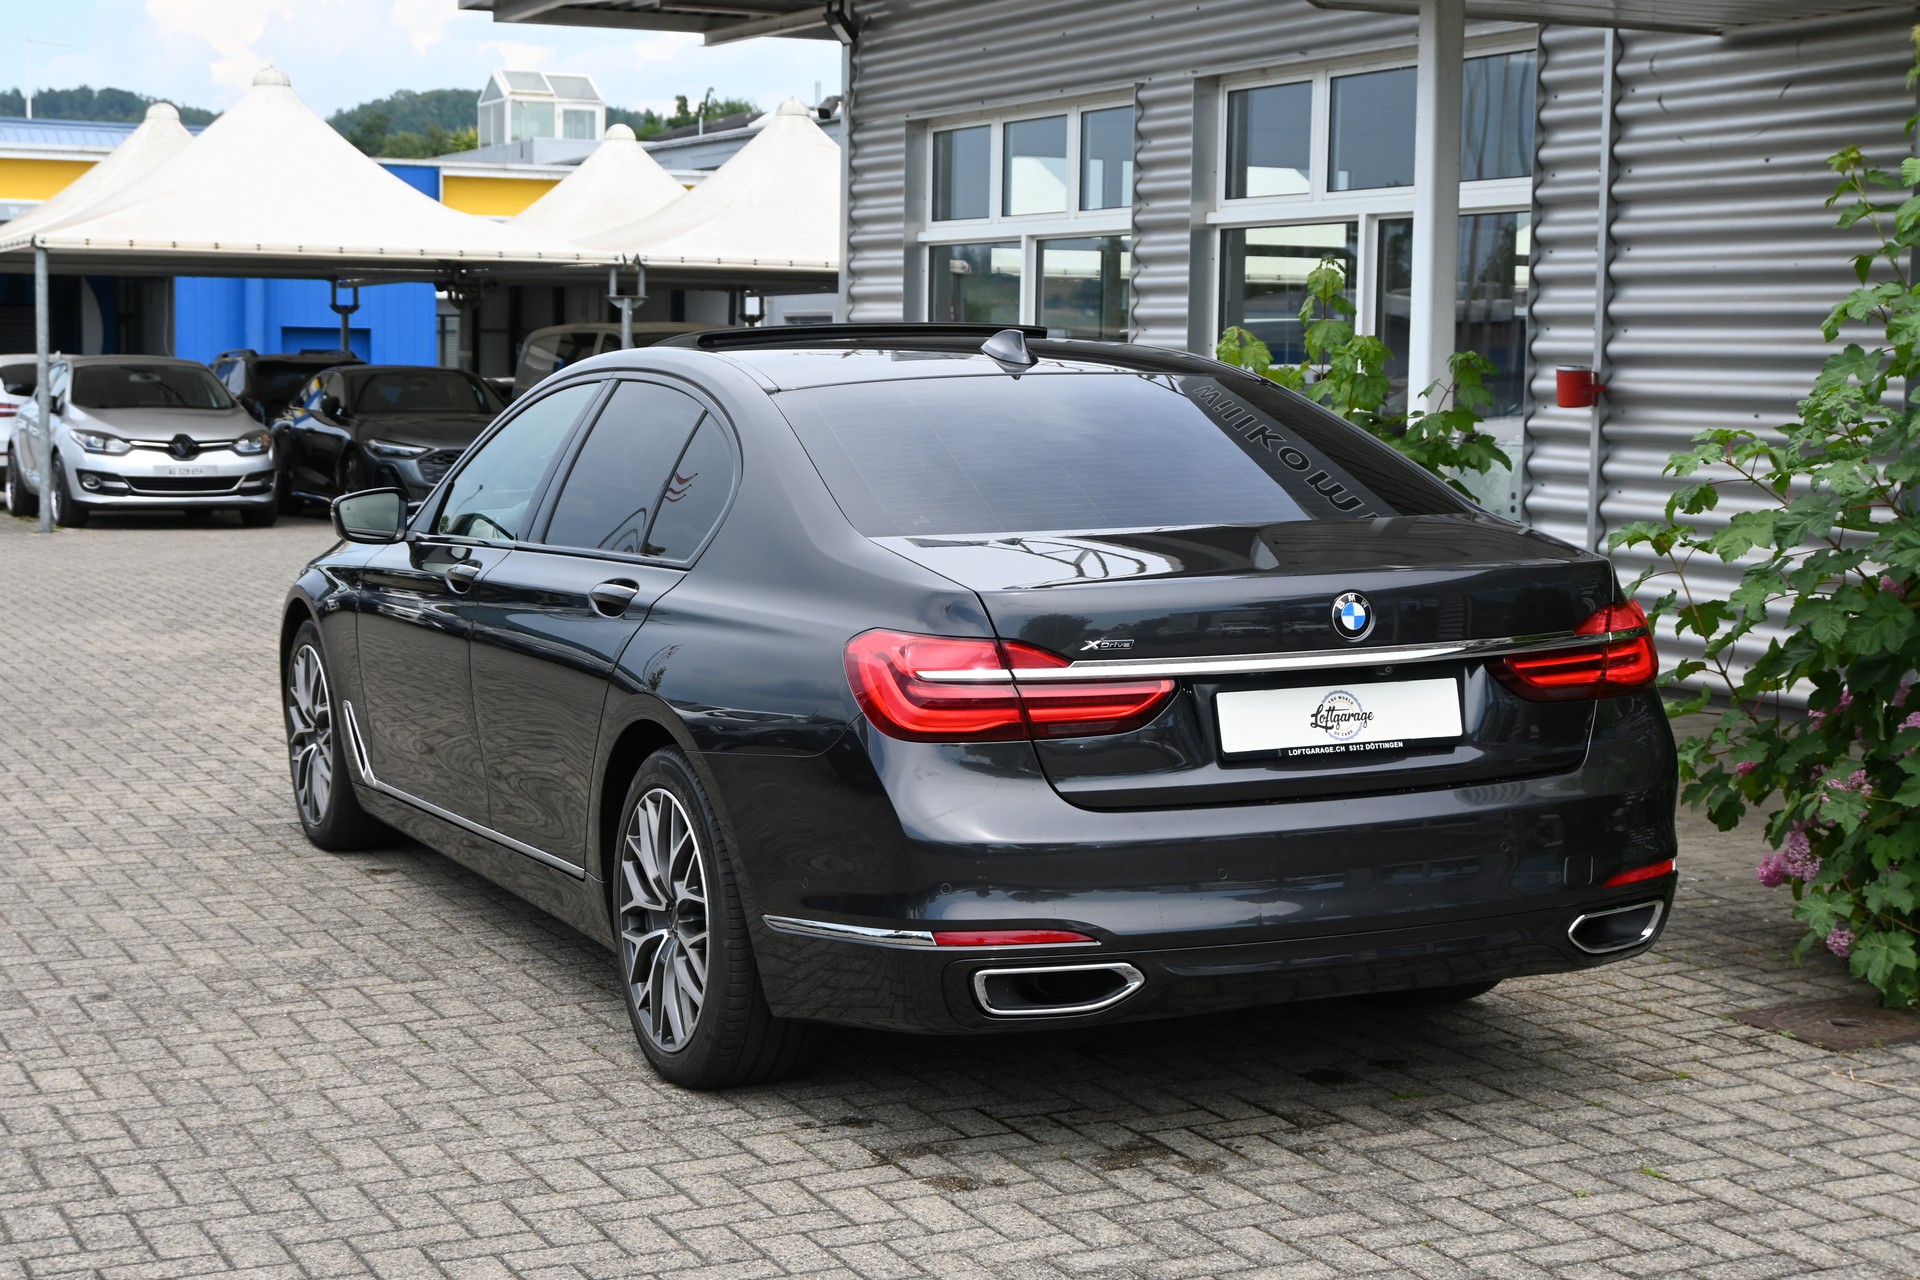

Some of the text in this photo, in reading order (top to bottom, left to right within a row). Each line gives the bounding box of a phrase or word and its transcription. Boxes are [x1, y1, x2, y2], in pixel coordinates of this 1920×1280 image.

[1336, 594, 1368, 609] BMW
[1310, 703, 1374, 733] Loftgarage
[1288, 745, 1346, 755] LOFTGARAGE.CH
[1365, 741, 1403, 750] DÖTTINGEN
